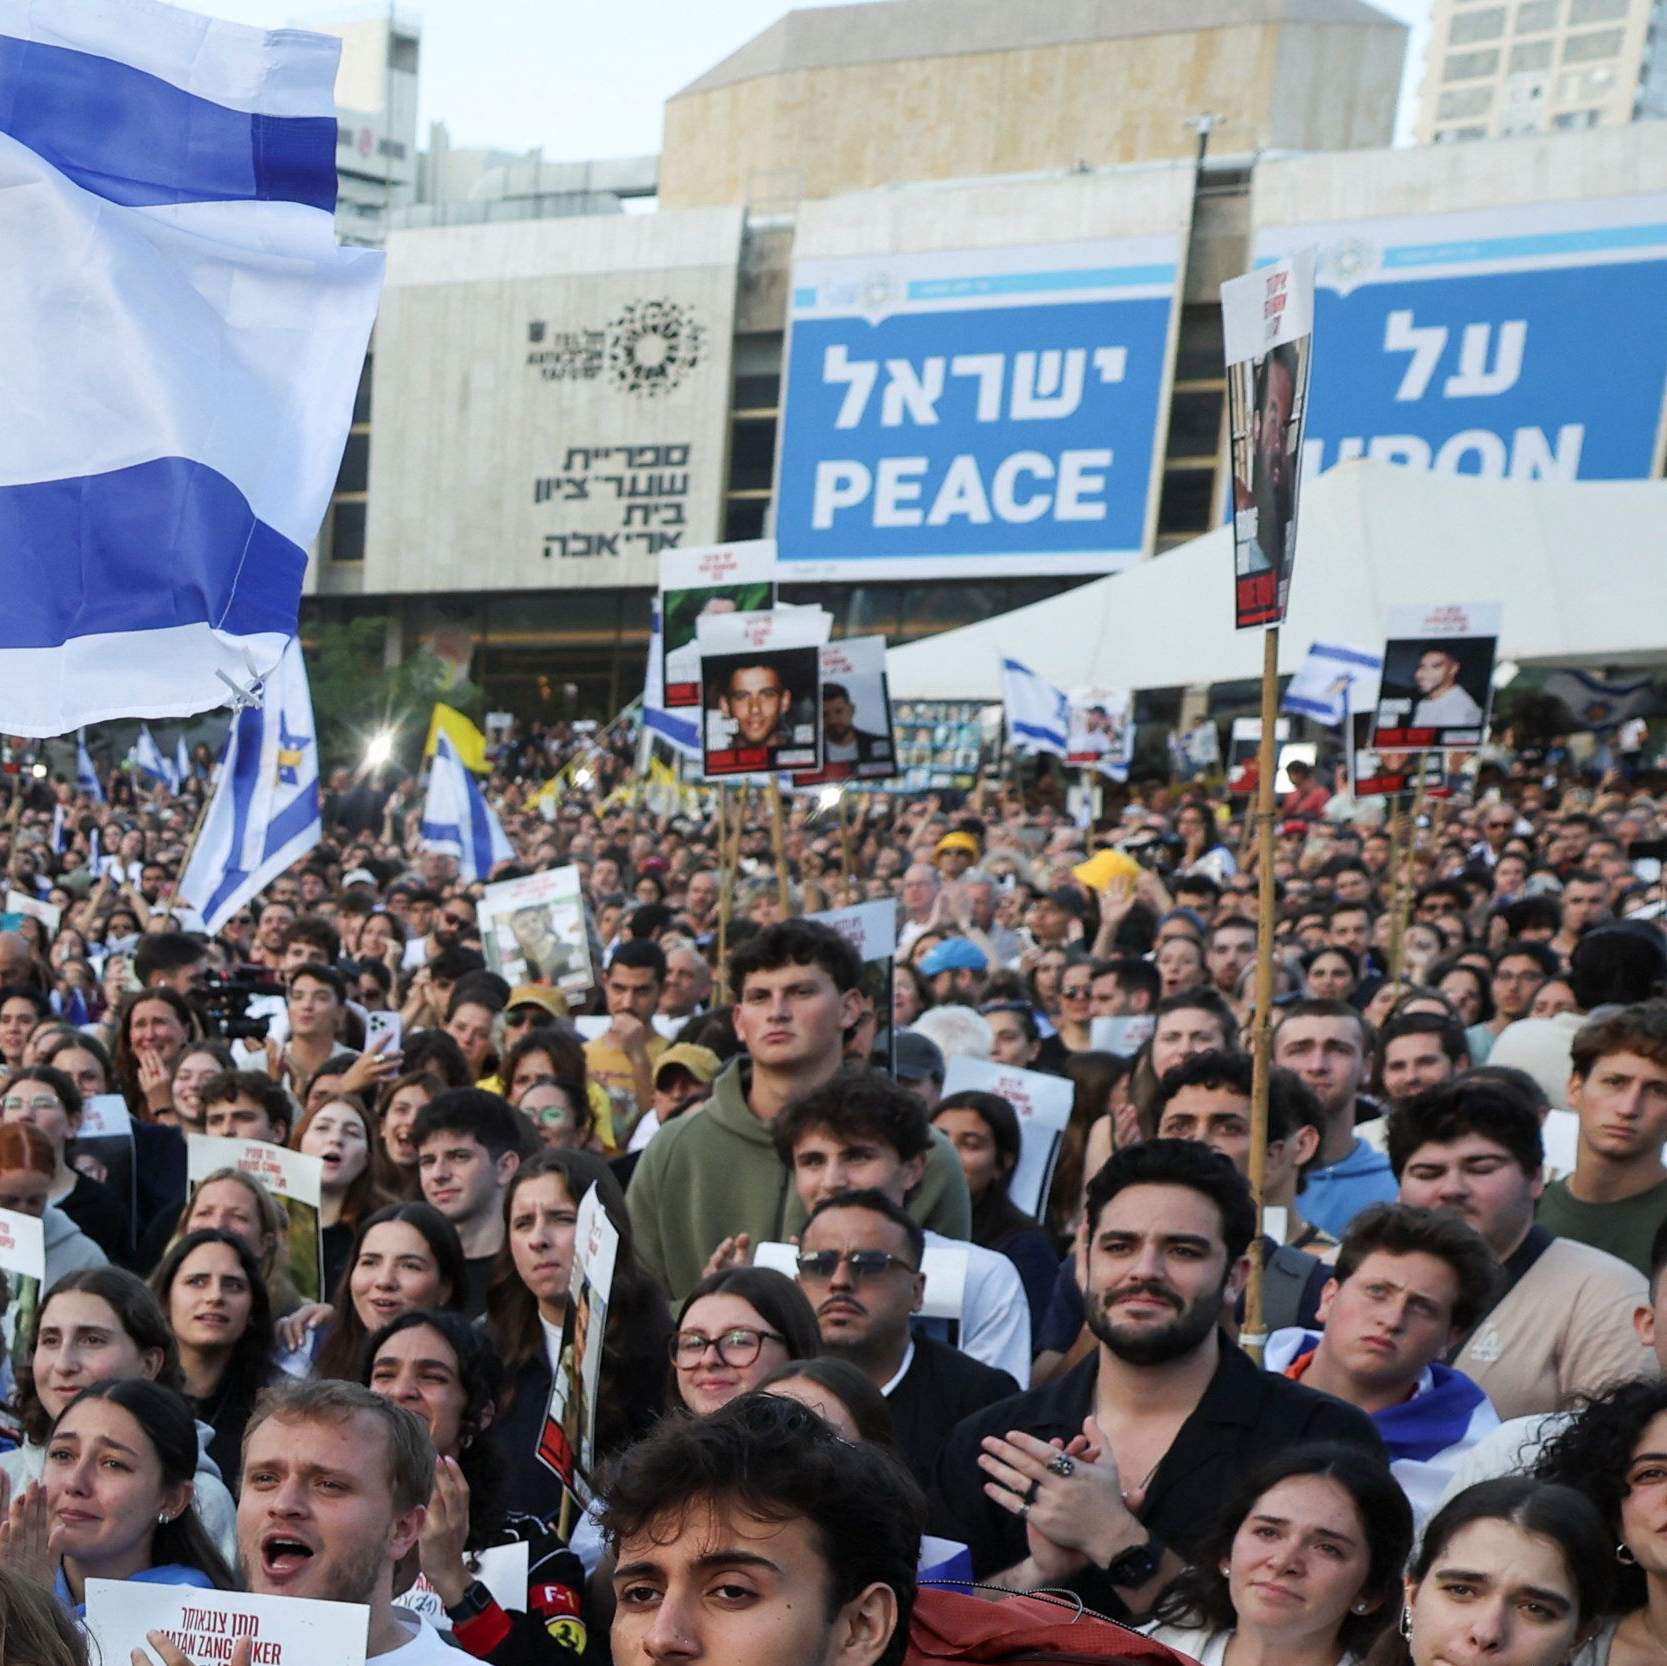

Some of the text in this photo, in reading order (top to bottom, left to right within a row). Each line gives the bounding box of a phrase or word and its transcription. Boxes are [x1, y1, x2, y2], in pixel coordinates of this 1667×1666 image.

[1383, 308, 1528, 402] על
[822, 344, 1128, 429] ישראל
[563, 443, 691, 471] ספריית
[812, 447, 1114, 530] PEACE
[623, 502, 686, 526] בית
[181, 1606, 260, 1638] מתן צנגאוקר
[197, 1635, 282, 1666] ZANGKER
